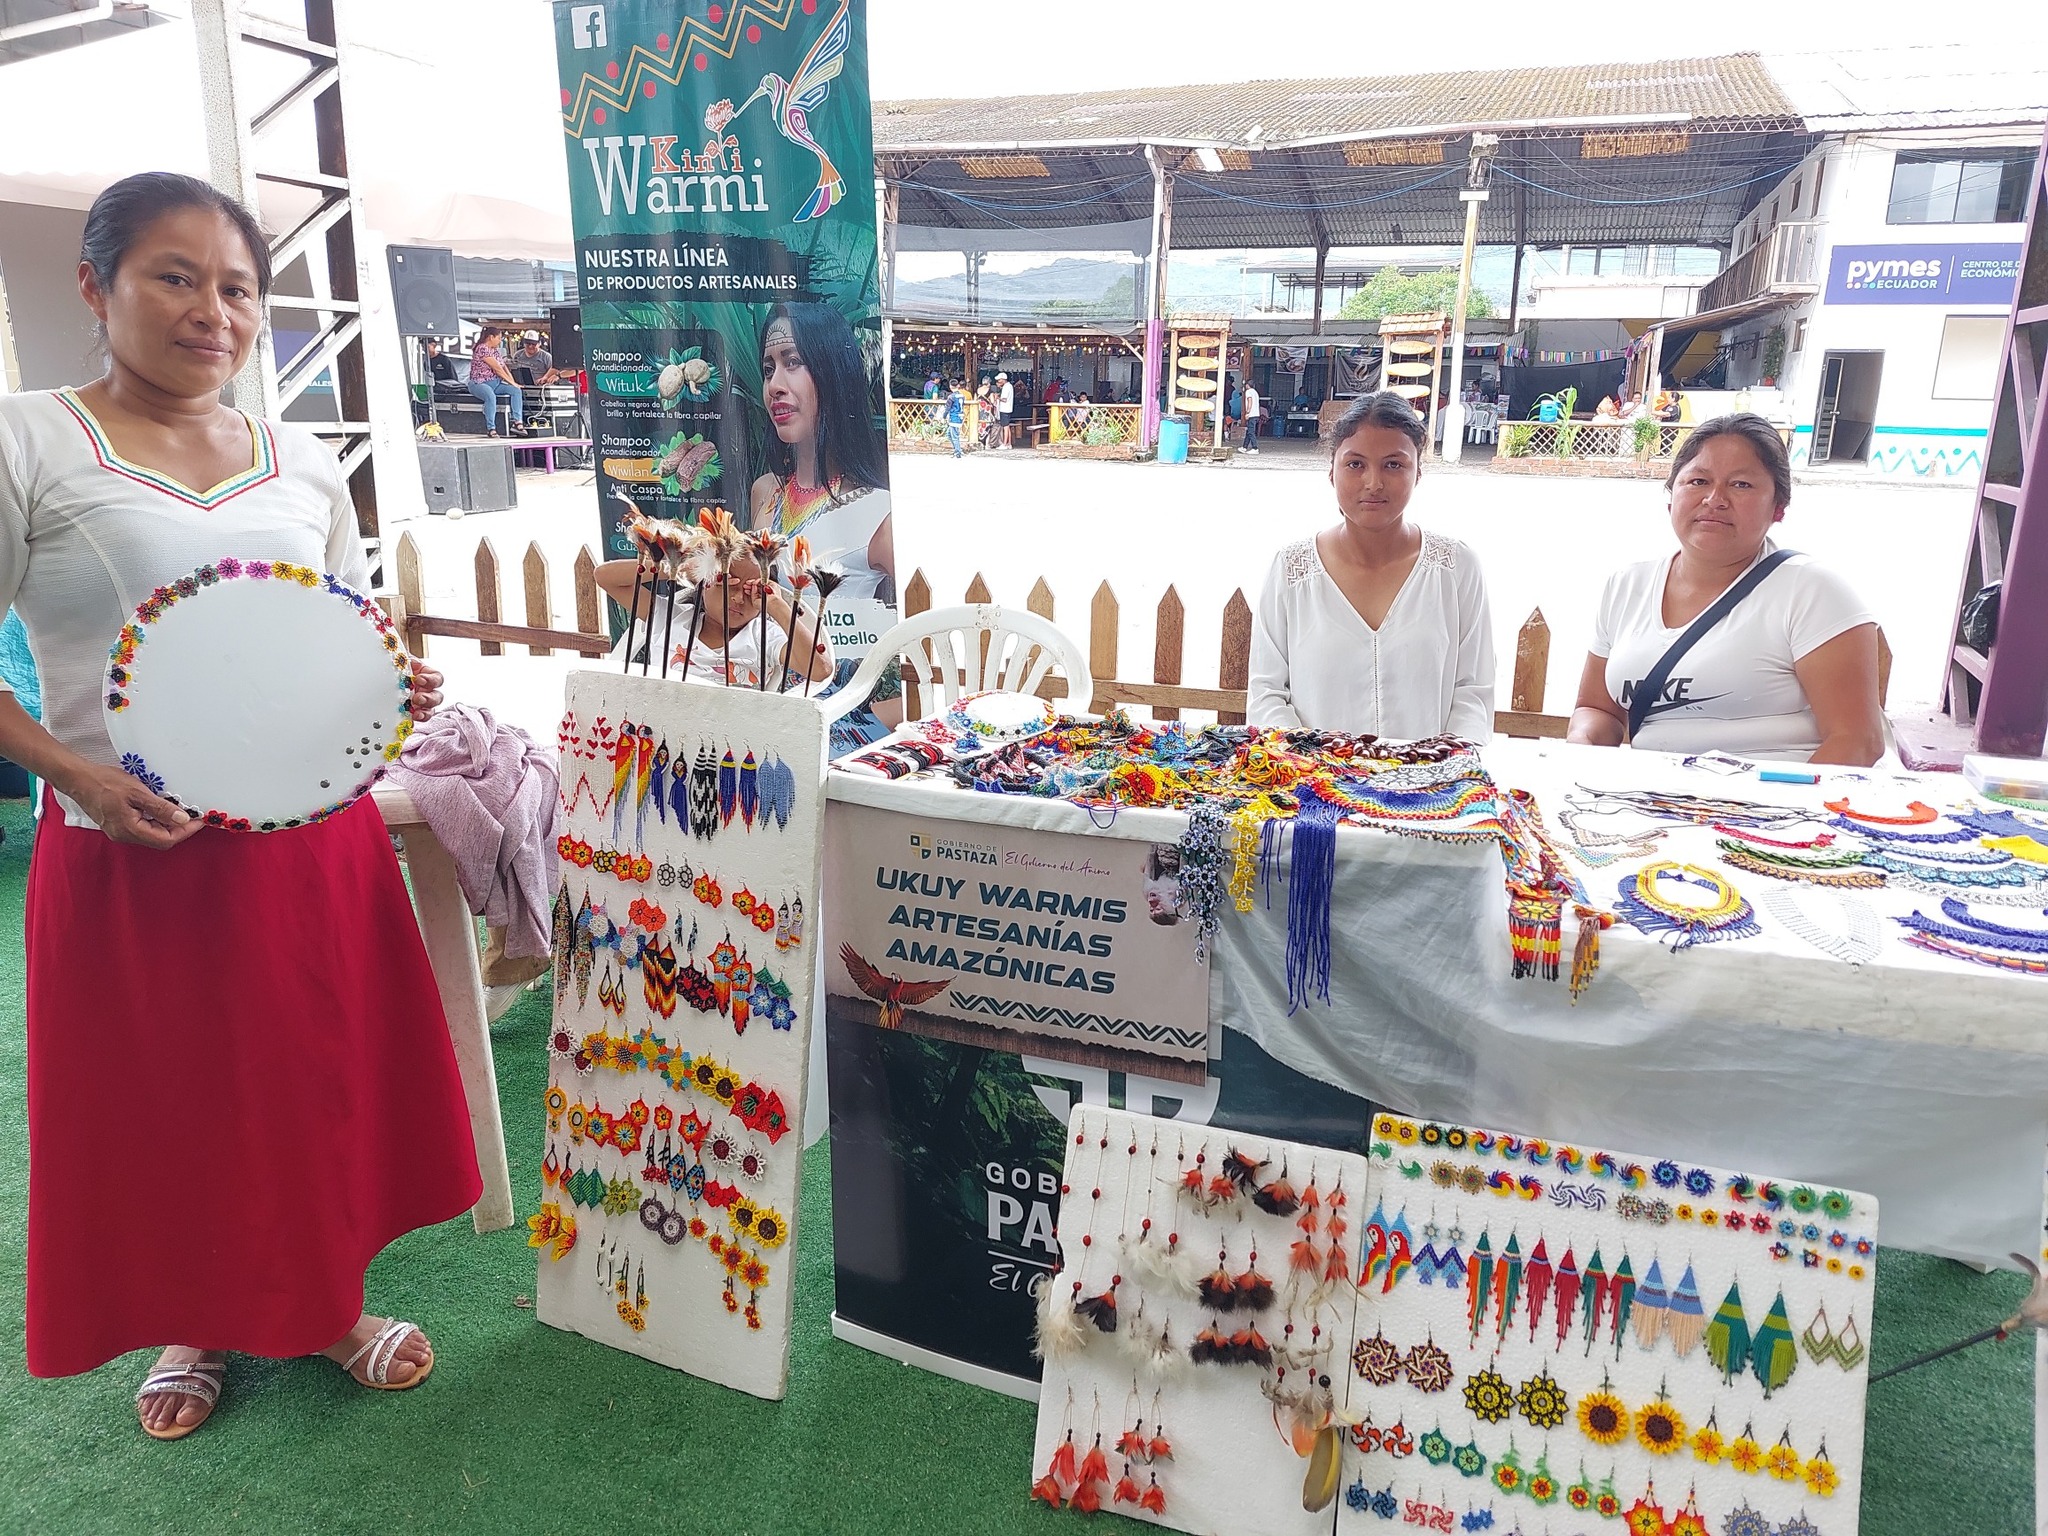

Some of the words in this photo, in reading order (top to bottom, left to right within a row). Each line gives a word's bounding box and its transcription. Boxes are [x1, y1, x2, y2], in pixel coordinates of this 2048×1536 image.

[582, 135, 769, 216] Warmi
[585, 248, 669, 268] NUESTRA
[673, 242, 729, 267] LÍNEA
[1847, 259, 1941, 283] pymes
[1962, 260, 2000, 268] CENTRO
[2000, 260, 2014, 268] DE
[587, 275, 604, 290] DE
[606, 275, 694, 291] PRODUCTOS
[698, 275, 798, 290] ARTESANALES
[1876, 279, 1938, 289] ECUADOR
[592, 348, 642, 364] Shampoo
[591, 363, 653, 372] Acondicionador
[605, 373, 646, 393] Wituk
[600, 399, 627, 408] Cabellos
[628, 401, 650, 410] negros
[606, 409, 624, 417] brillo
[632, 409, 665, 419] fortalece
[601, 434, 651, 447] Shampoo
[600, 448, 661, 457] Acondicionador
[629, 483, 663, 495] Caspa
[831, 631, 878, 646] abello
[1621, 677, 1694, 703] NKE
[936, 838, 983, 851] GOBIERNO
[936, 846, 998, 866] PASTAZA
[1004, 851, 1019, 865] El
[1020, 853, 1057, 871] Gobierno
[1059, 859, 1075, 873] del
[876, 866, 966, 901] UKUY
[978, 881, 1128, 925] WARMIS
[887, 903, 1114, 959] ARTESANÍAS
[885, 938, 1116, 995] AMAZÓNICAS
[988, 1262, 1021, 1292] El
